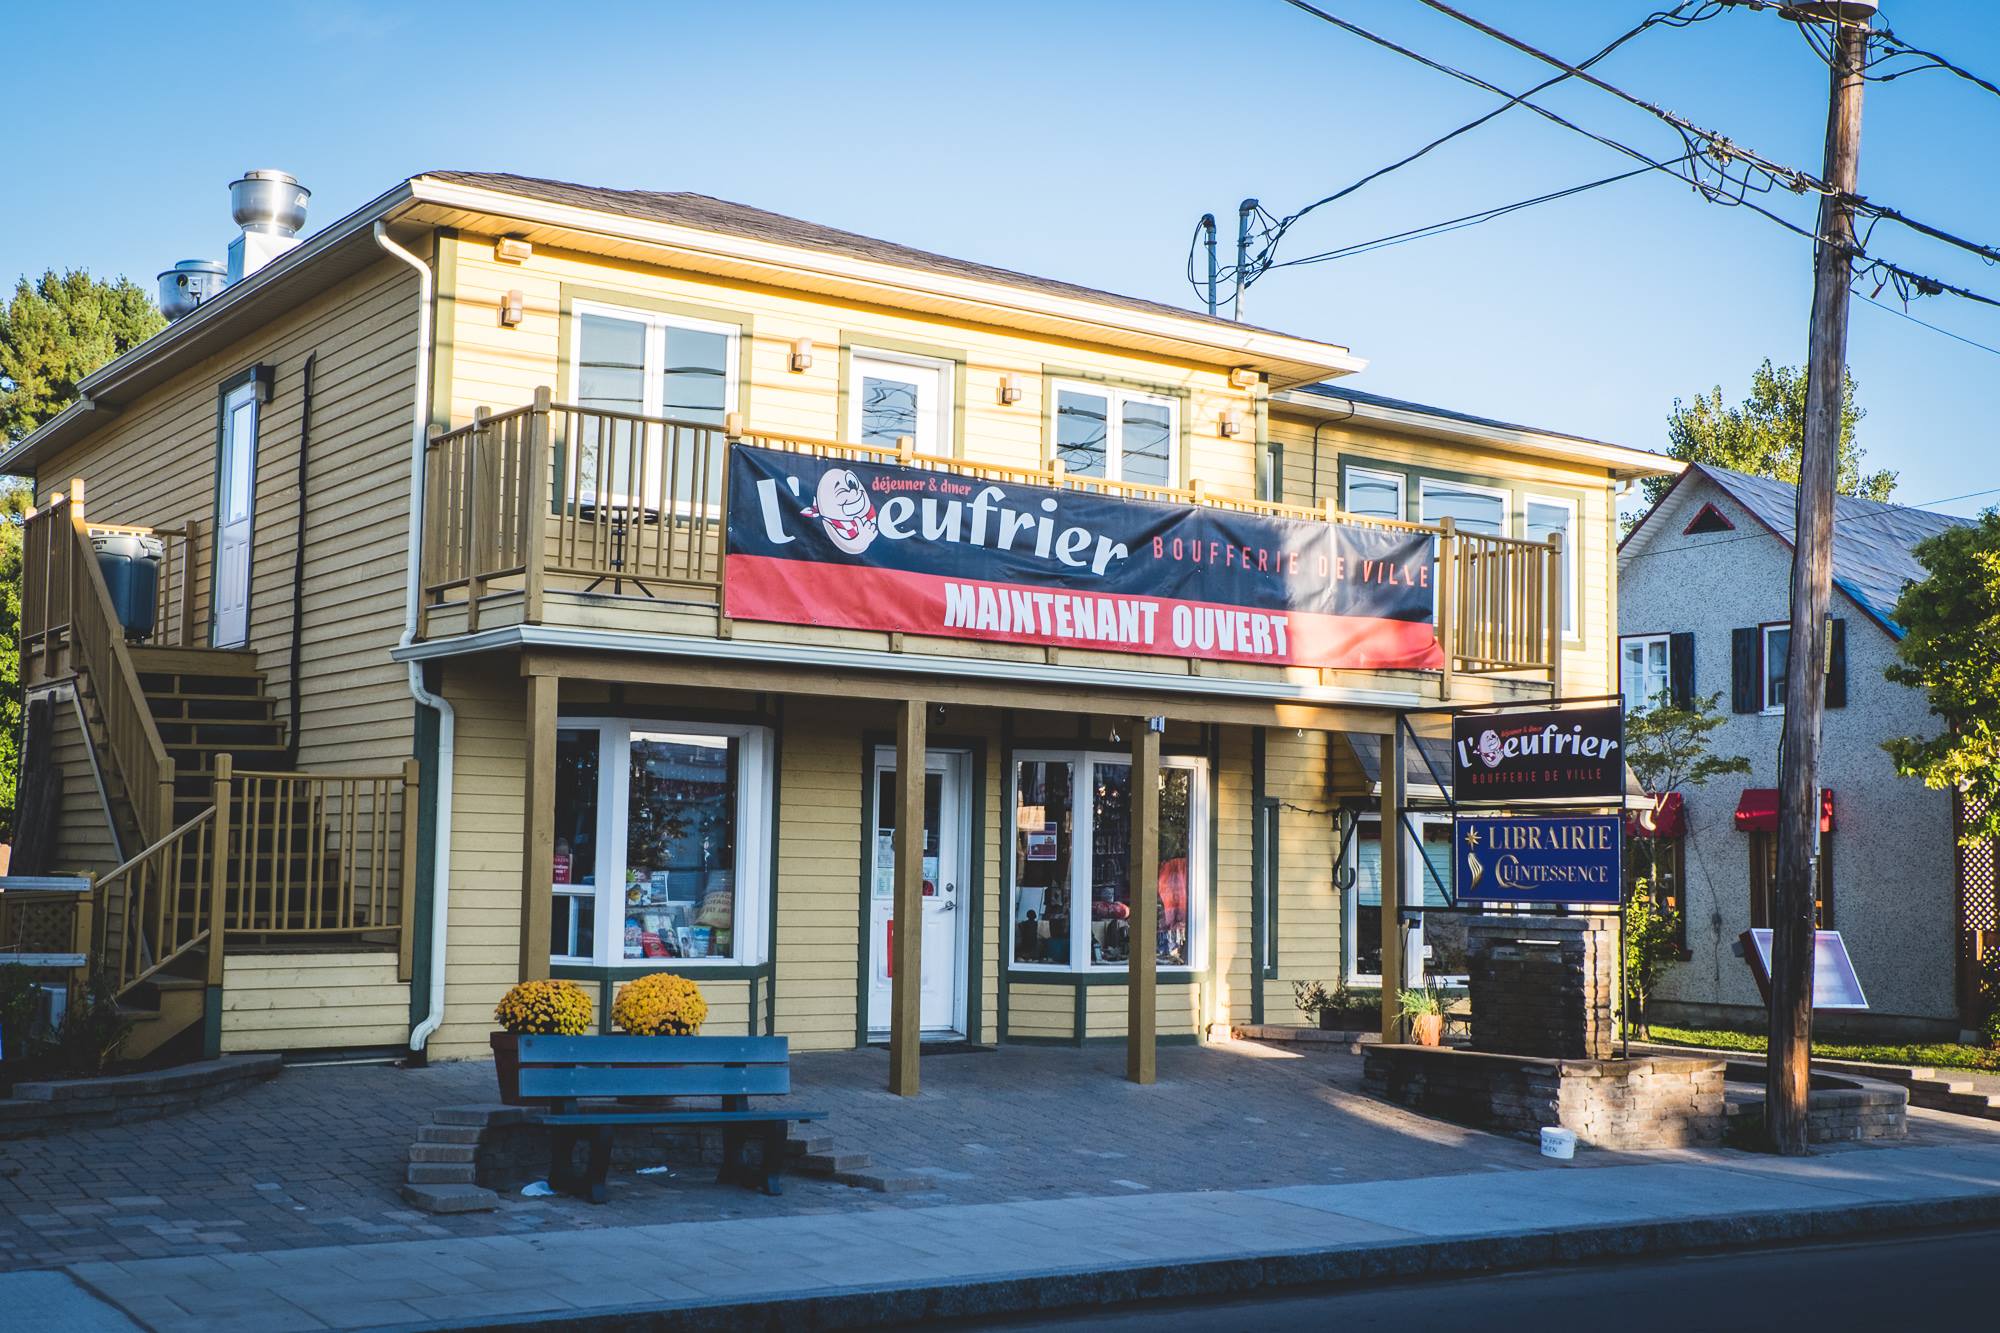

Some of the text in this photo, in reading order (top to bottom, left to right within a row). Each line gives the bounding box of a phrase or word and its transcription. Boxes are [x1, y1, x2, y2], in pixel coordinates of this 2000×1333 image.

[872, 476, 926, 494] déjeuner
[929, 478, 938, 491] &
[1153, 536, 1429, 588] BOUFFERIE DE VILLE
[944, 582, 1290, 656] MAINTENANT OUVERT
[1472, 768, 1602, 785] BOUFFERIE DE VILLE
[1489, 825, 1613, 850] LIBRAIRIE
[1495, 854, 1609, 890] QUINTESSENCE
